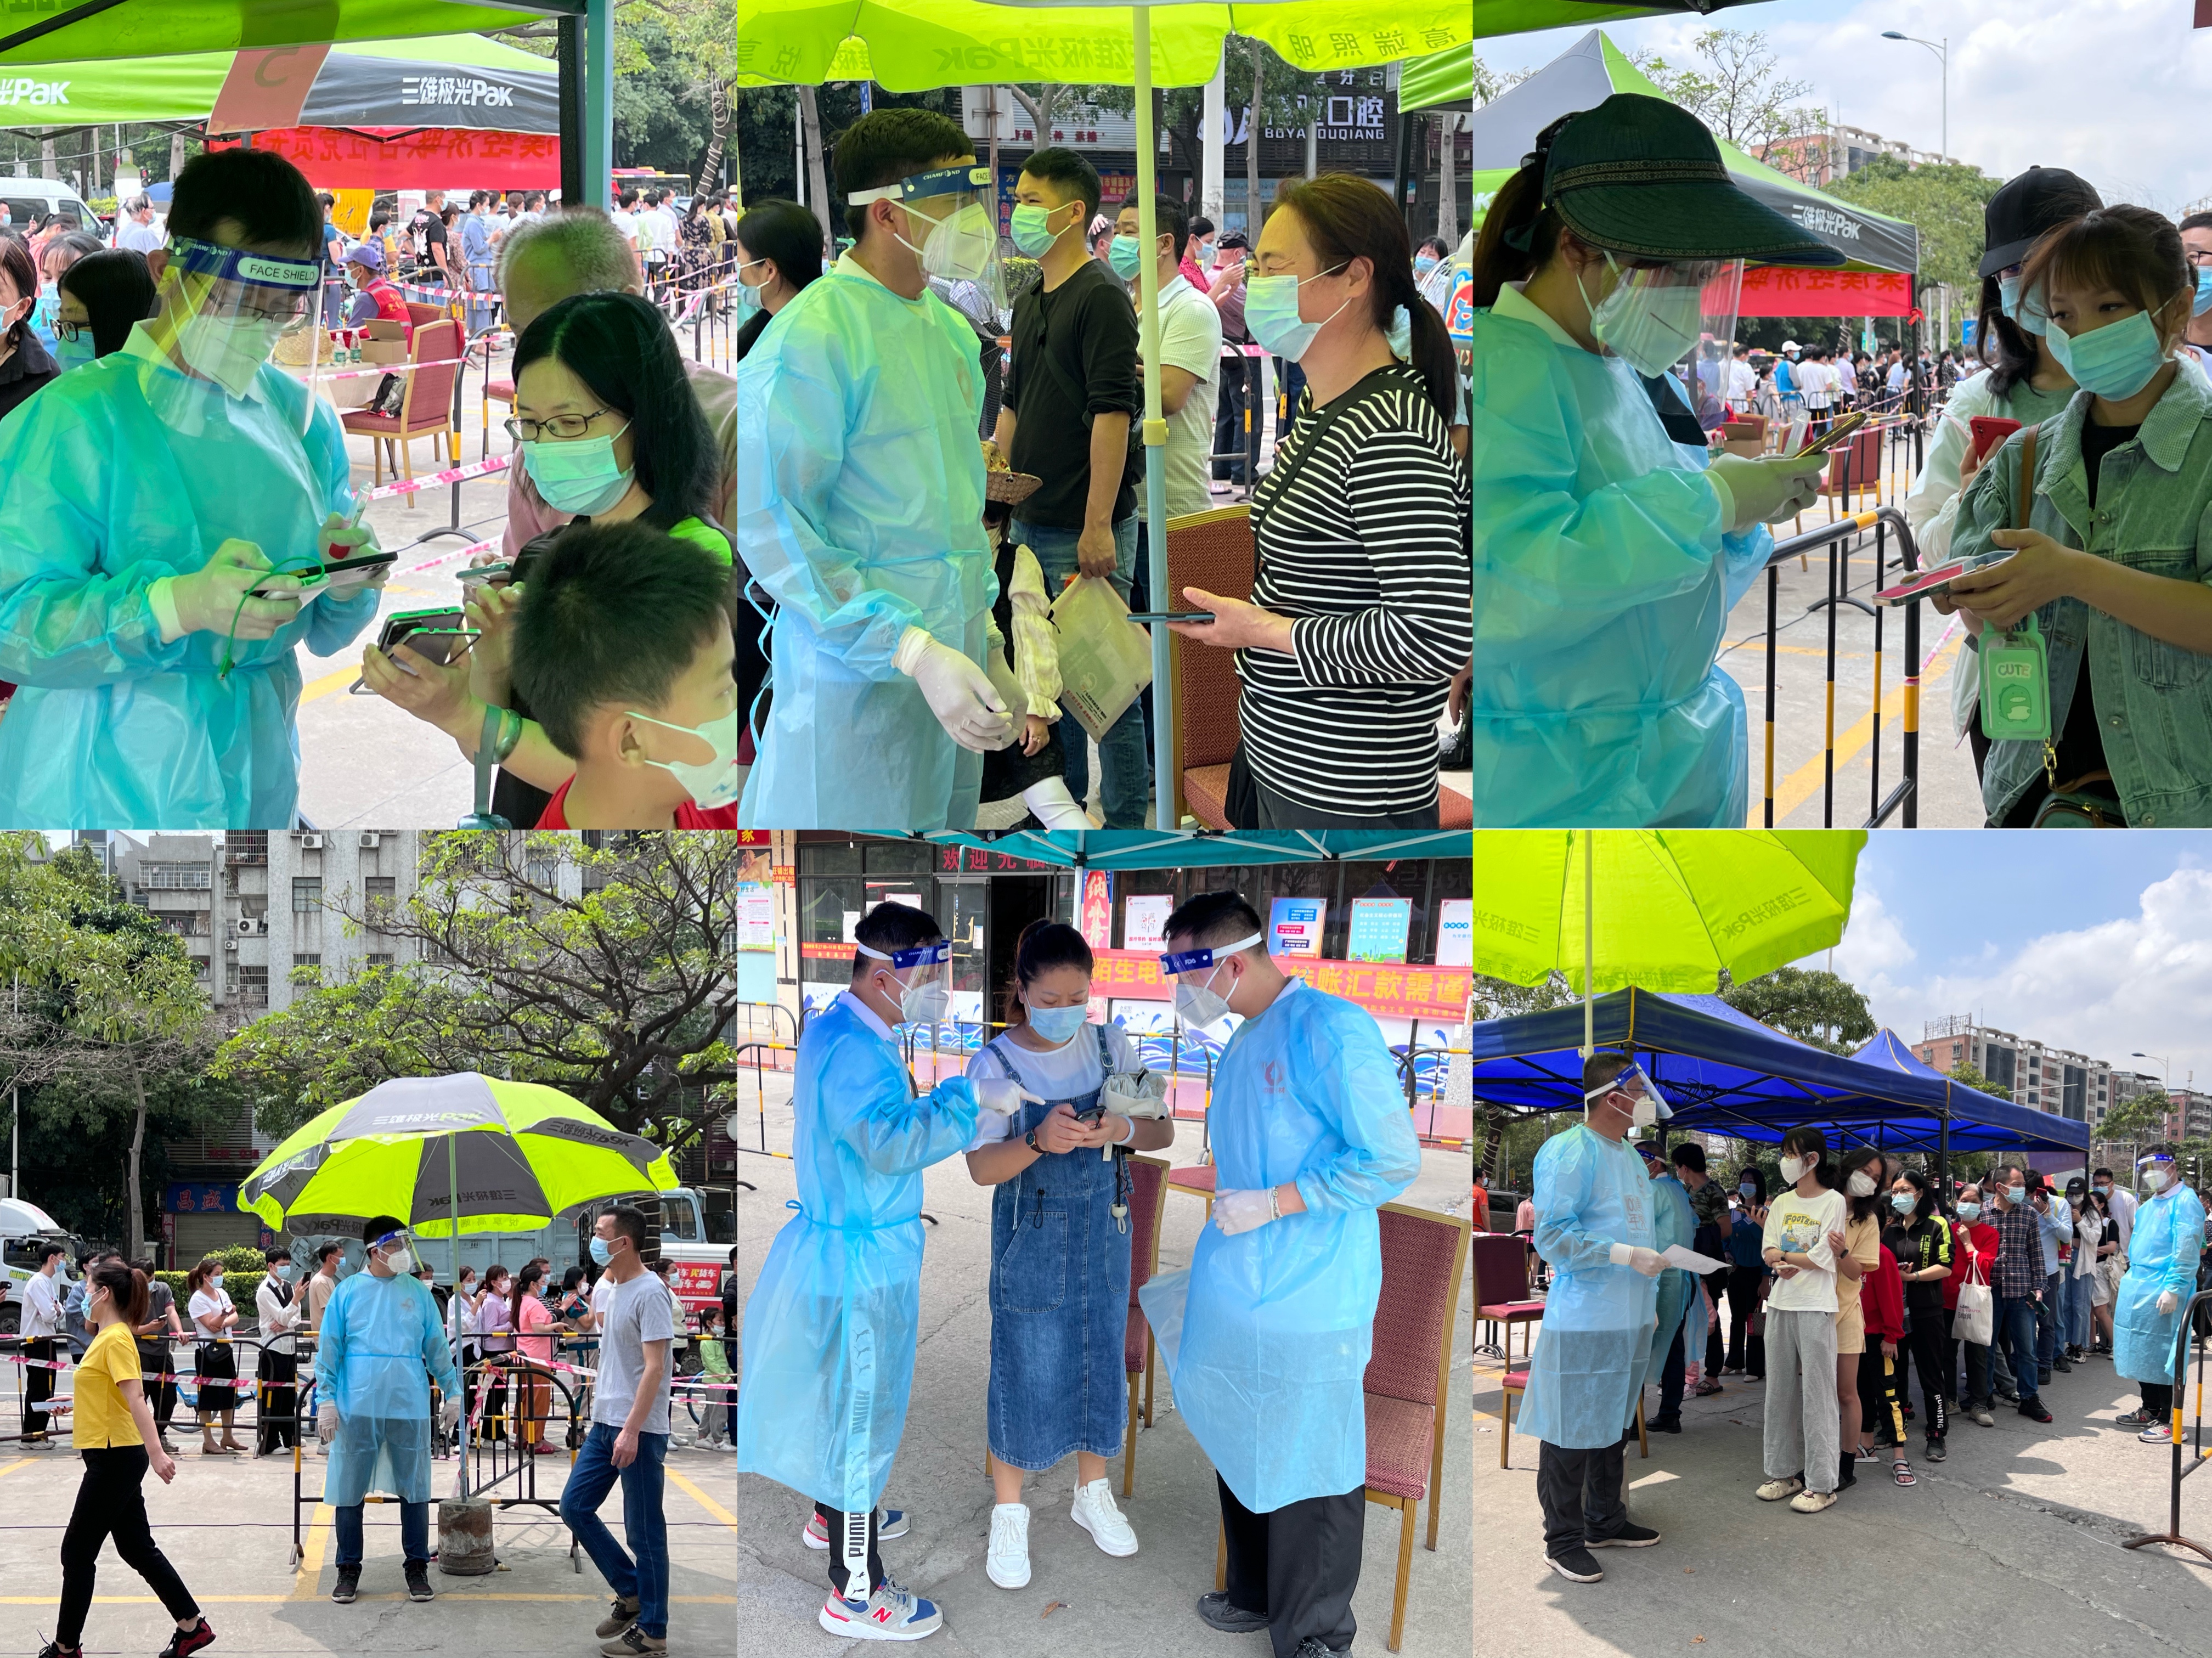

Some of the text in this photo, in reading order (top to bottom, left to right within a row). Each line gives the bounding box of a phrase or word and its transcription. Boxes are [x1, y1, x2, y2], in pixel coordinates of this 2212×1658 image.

[250, 264, 315, 281] FACE SHIELD
[1997, 664, 2030, 676] CUTE
[1289, 965, 1473, 1004] 转账汇款需谨
[177, 1189, 225, 1211] 昌盛
[1785, 1214, 1819, 1226] FOOTBALL
[1934, 1394, 1944, 1429] RUNNING
[842, 1610, 854, 1619] 999
